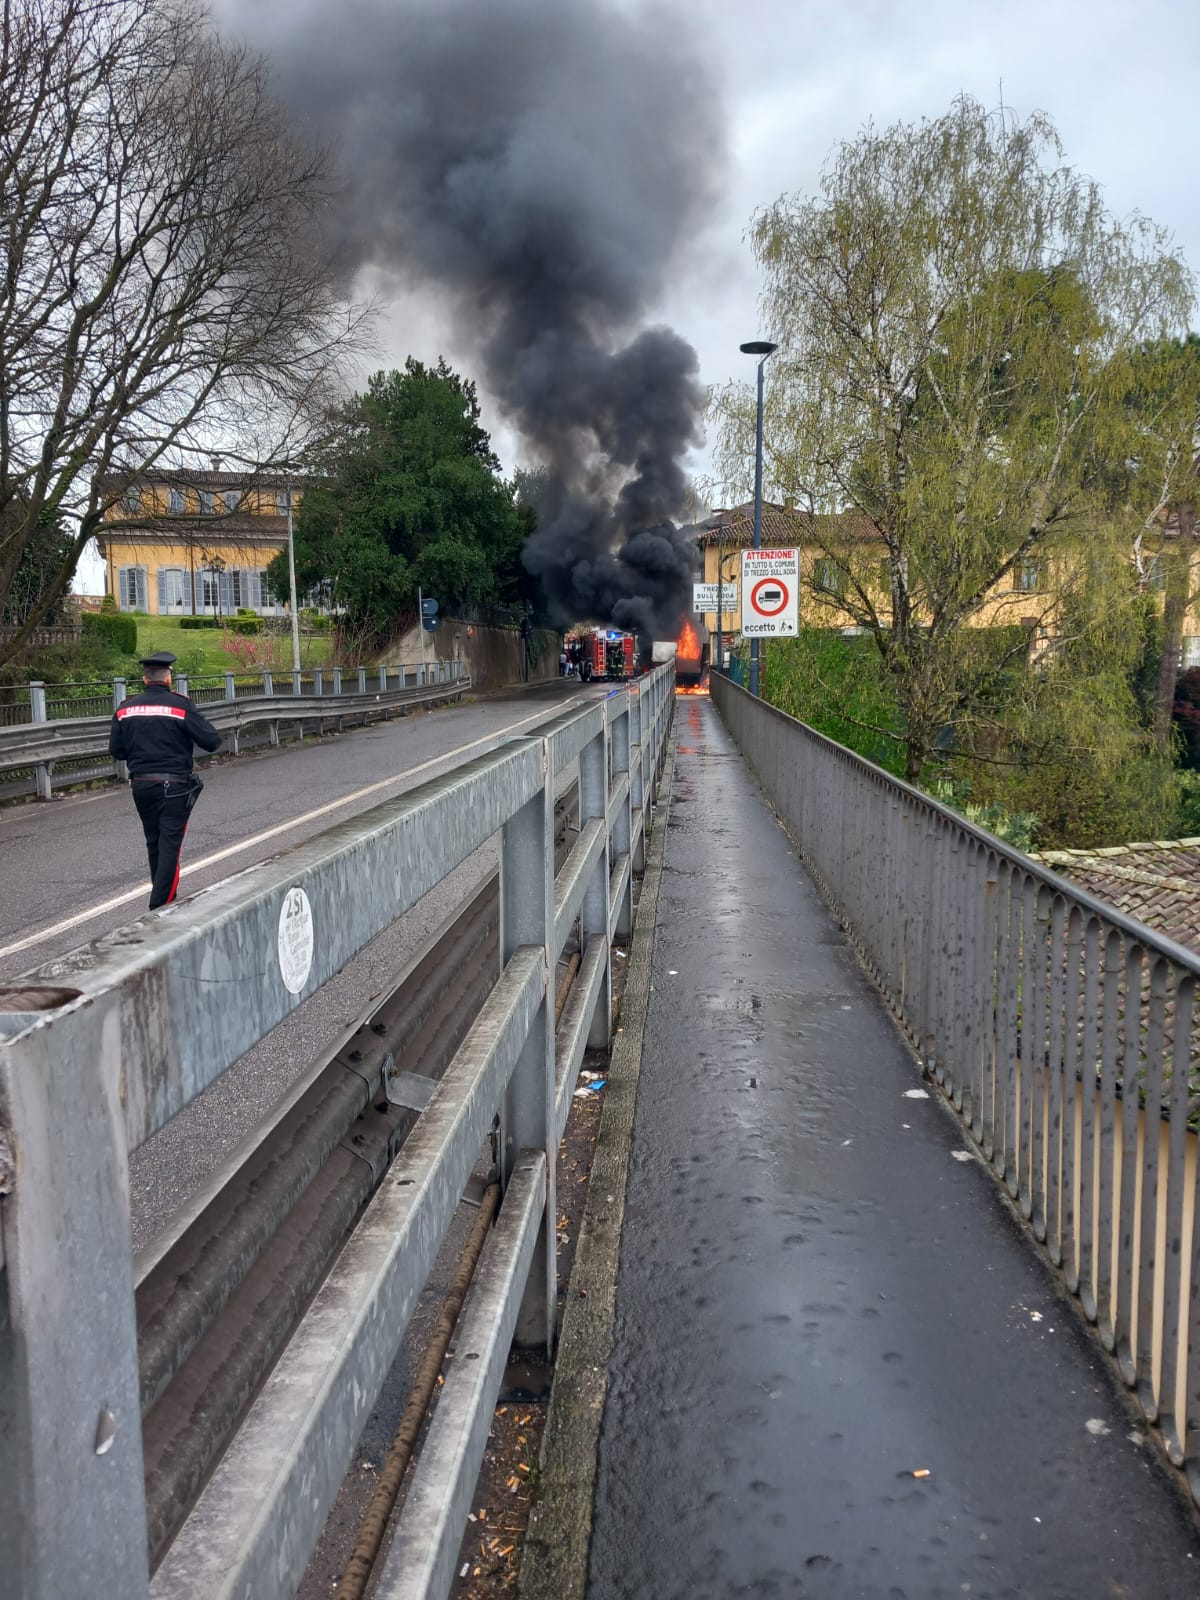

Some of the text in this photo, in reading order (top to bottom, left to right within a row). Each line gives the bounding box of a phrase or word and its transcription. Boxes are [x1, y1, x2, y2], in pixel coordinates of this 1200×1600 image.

[746, 551, 795, 560] ATTENZIONE!
[751, 561, 768, 569] TUTTO
[774, 560, 795, 568] COMUNE
[744, 622, 776, 632] eccetto
[126, 705, 172, 714] CARABINIERI
